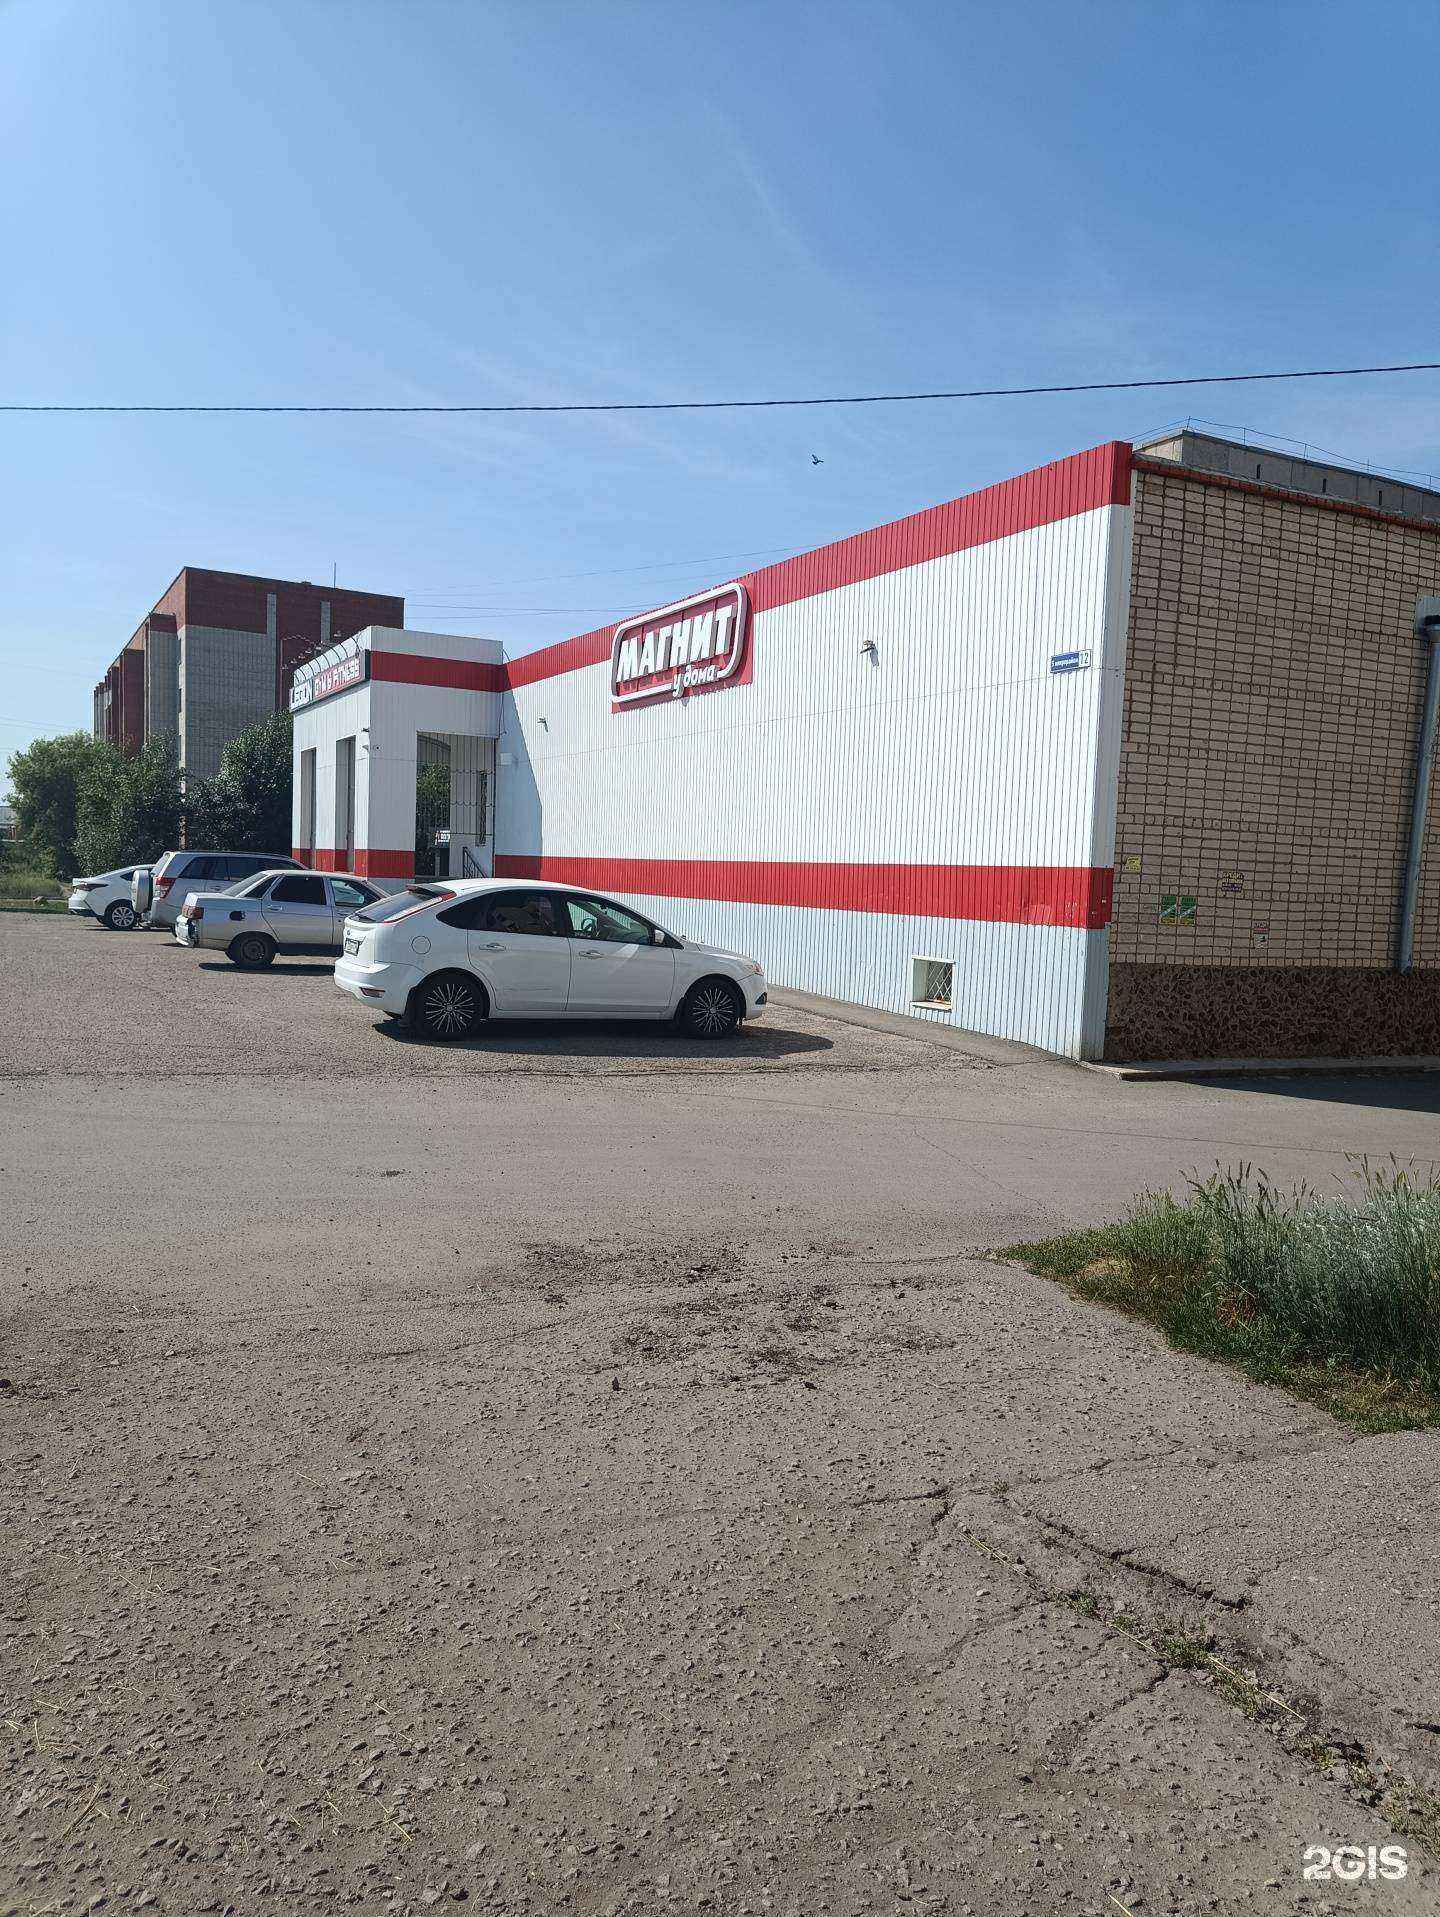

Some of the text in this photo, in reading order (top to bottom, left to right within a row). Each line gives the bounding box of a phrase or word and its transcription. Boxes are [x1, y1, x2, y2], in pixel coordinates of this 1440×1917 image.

[616, 604, 734, 682] МАГНИТ
[1080, 652, 1089, 665] 12
[673, 664, 716, 698] у дома
